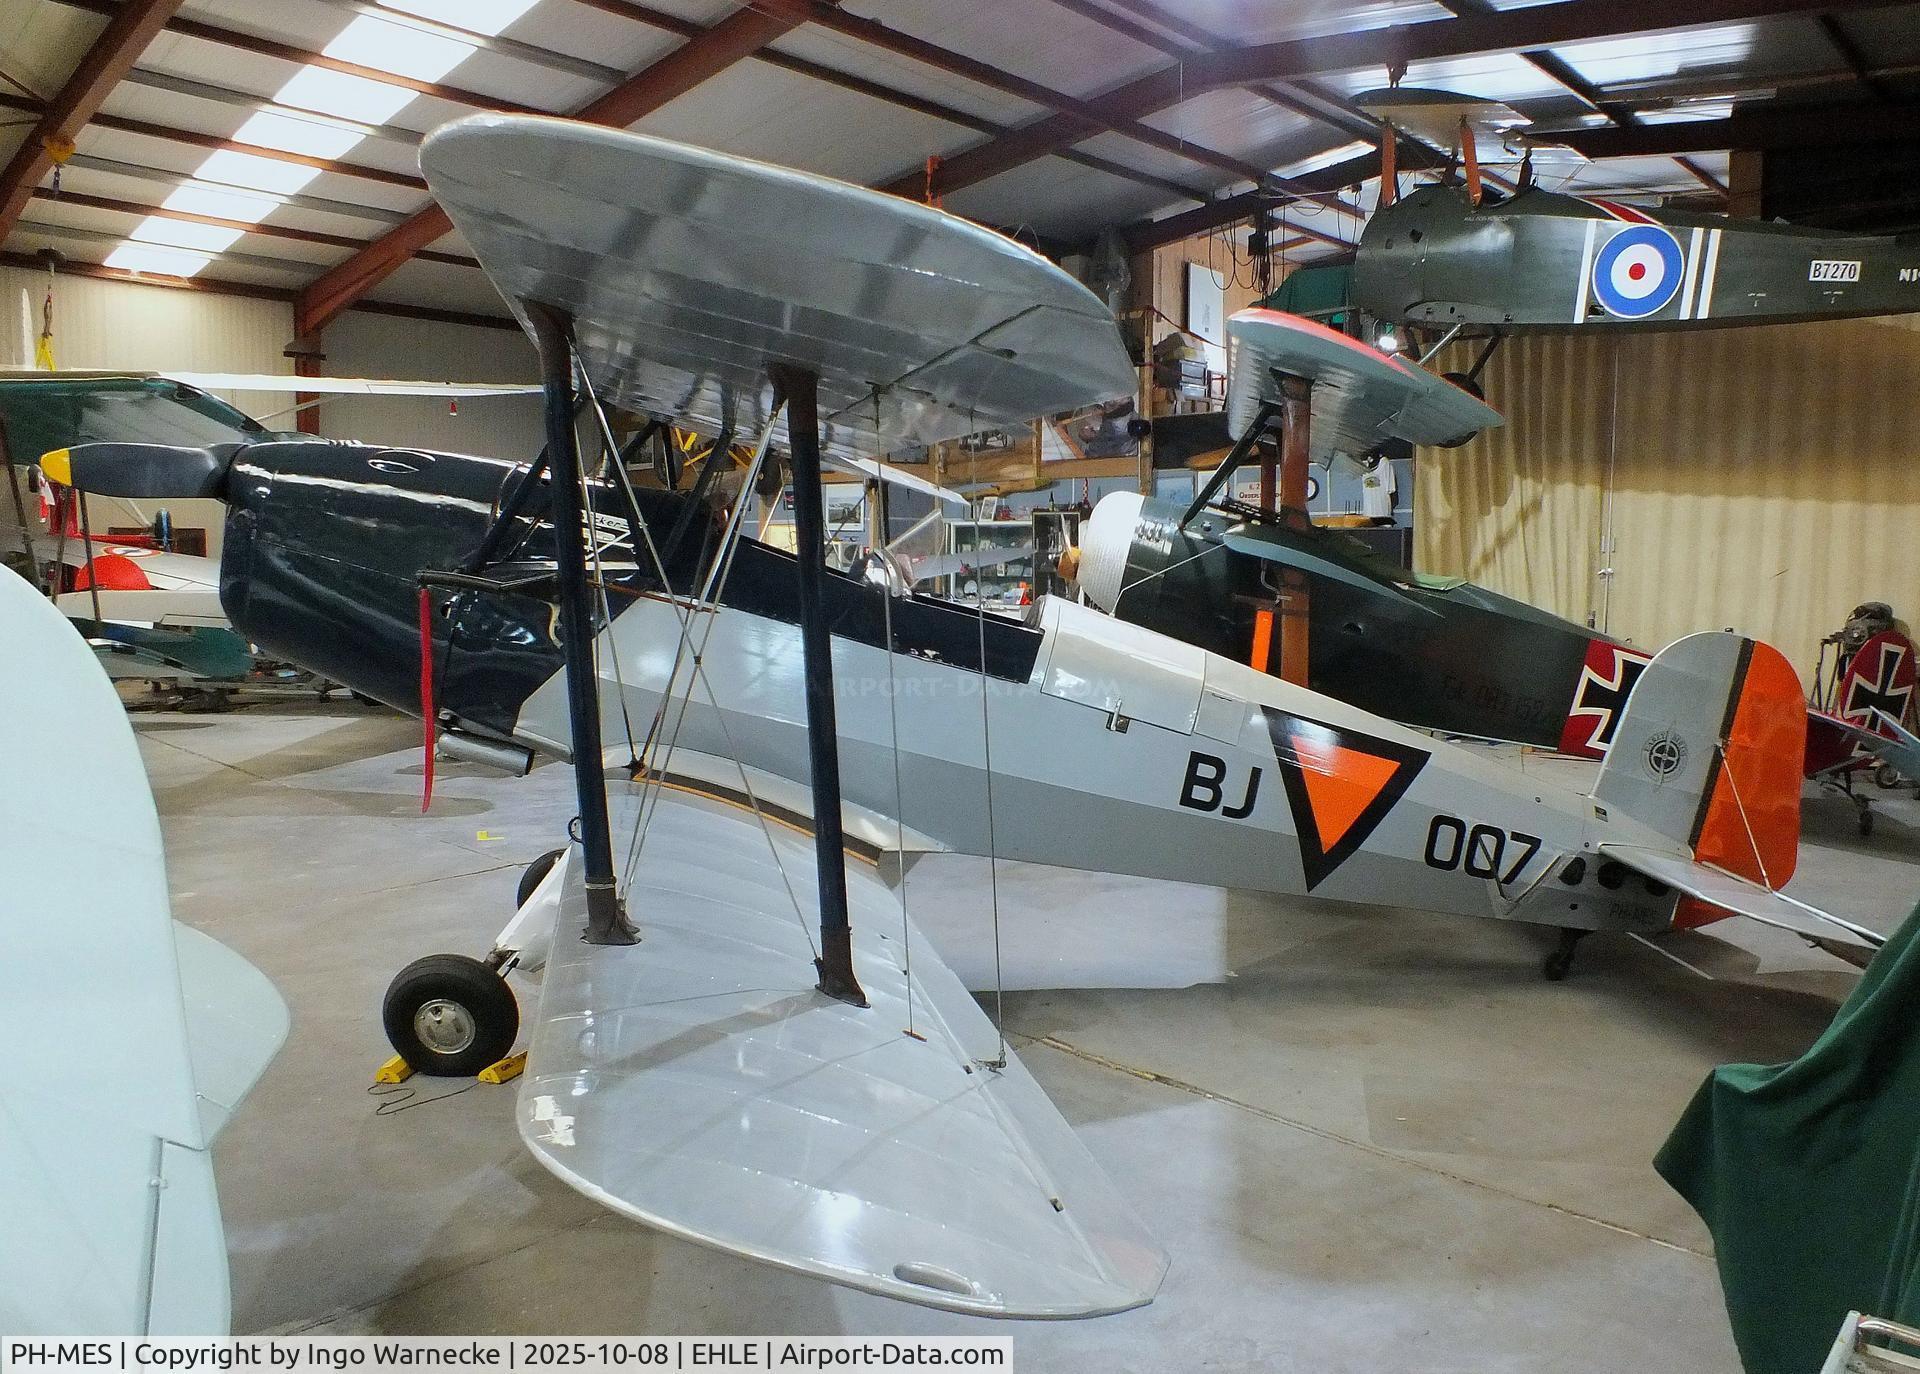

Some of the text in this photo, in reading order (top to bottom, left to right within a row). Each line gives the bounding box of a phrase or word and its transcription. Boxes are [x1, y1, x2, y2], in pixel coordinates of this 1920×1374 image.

[1812, 263, 1857, 279] B7270
[1899, 268, 1920, 282] N1
[1179, 750, 1263, 819] BJ
[1424, 814, 1542, 885] 007
